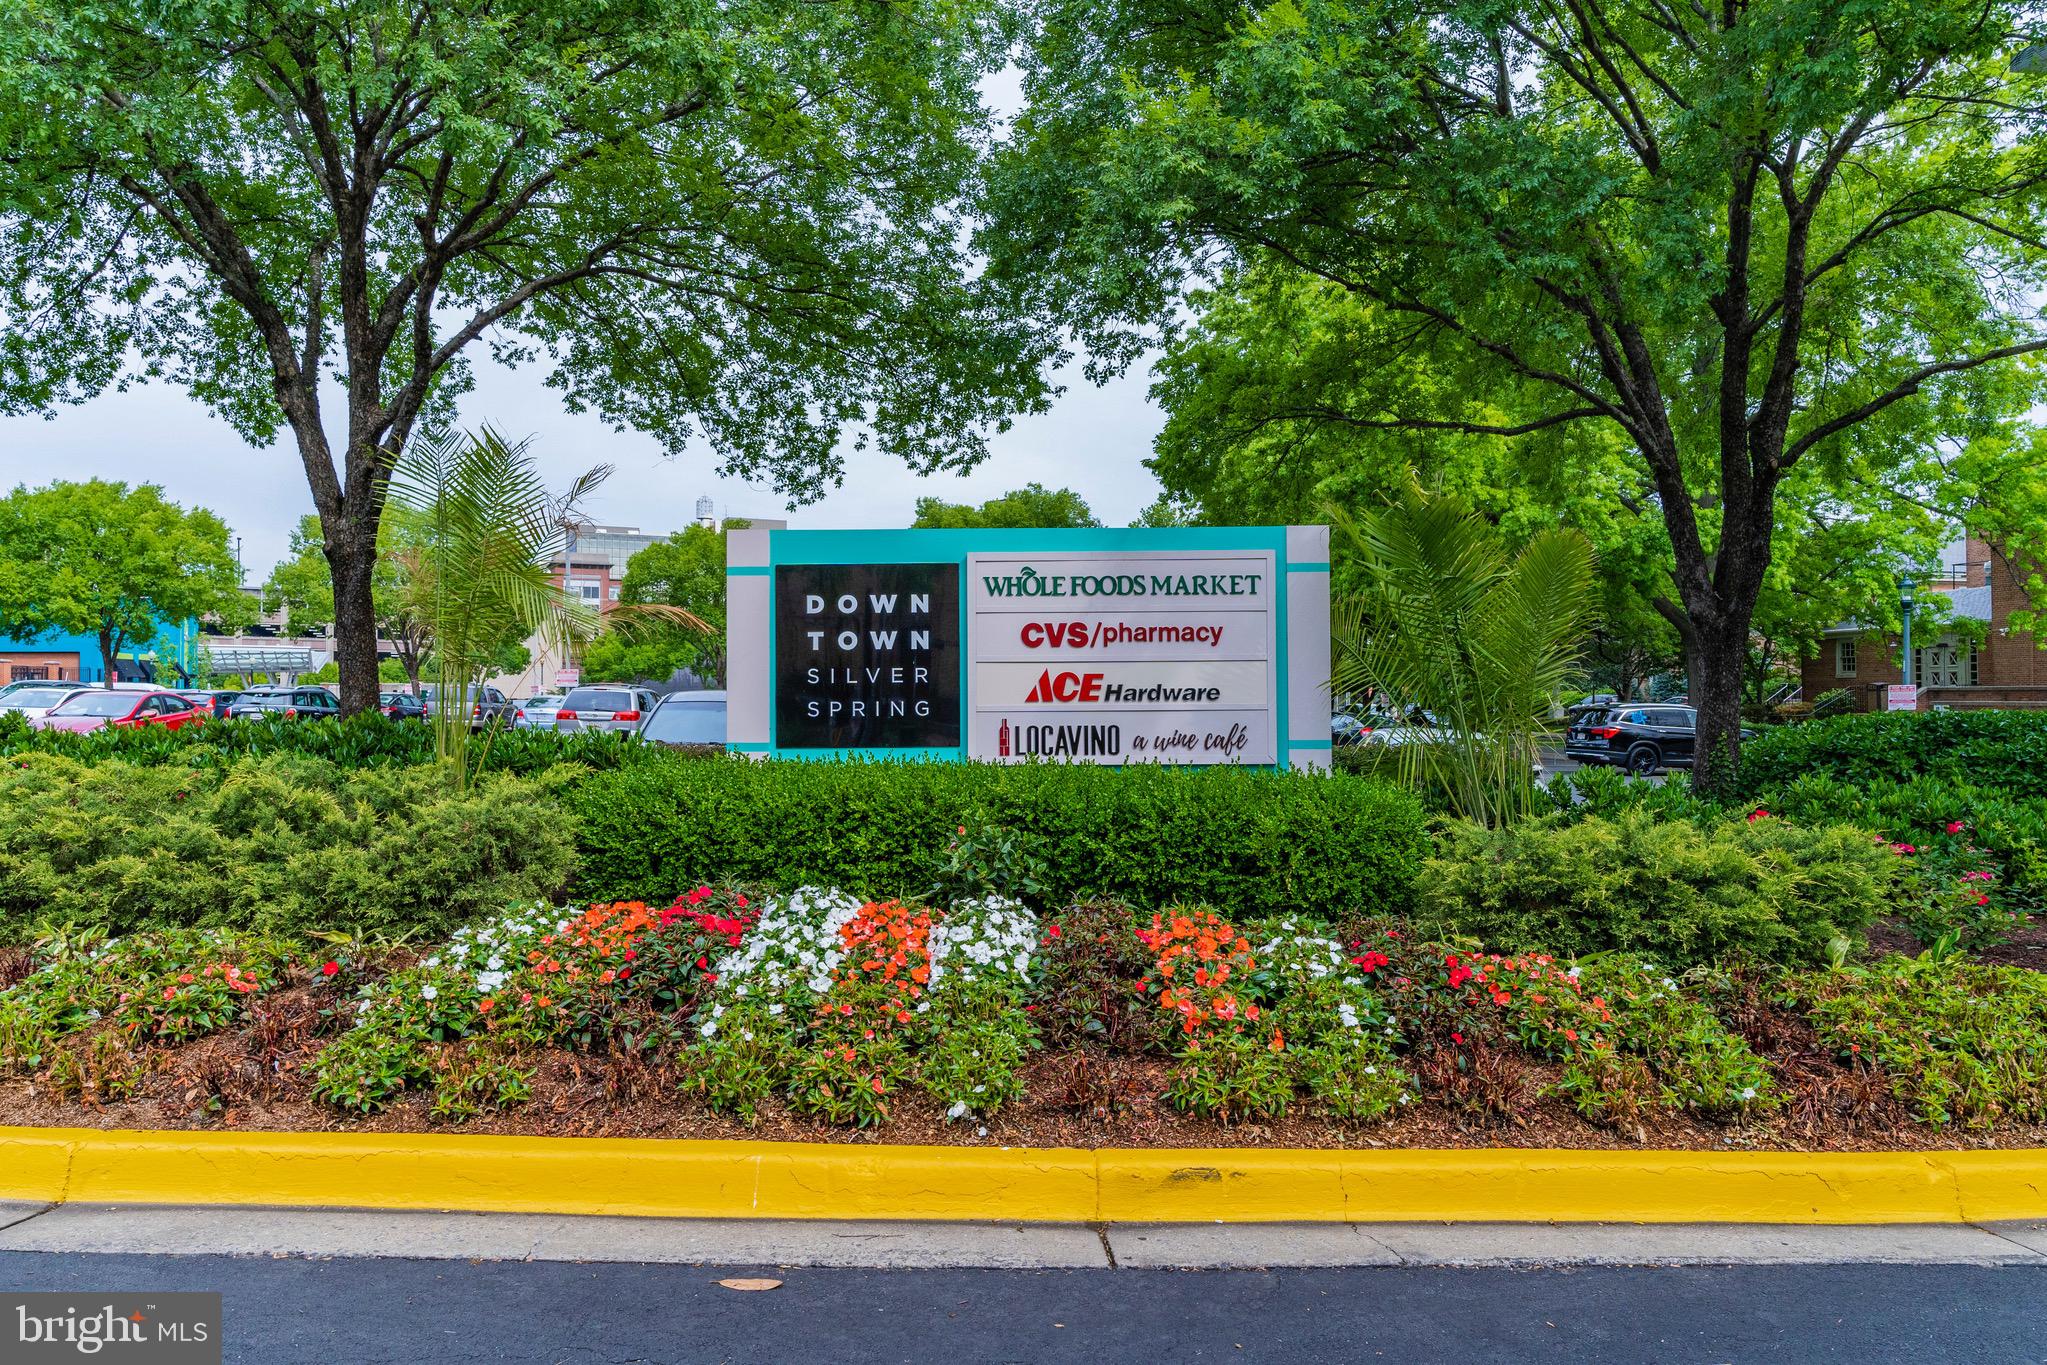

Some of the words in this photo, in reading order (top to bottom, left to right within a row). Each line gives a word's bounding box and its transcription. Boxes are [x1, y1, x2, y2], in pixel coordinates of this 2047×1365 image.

[982, 575, 1065, 597] WHOLE
[1071, 576, 1146, 597] FOODS
[1151, 575, 1261, 596] MARKET
[806, 594, 929, 614] DOWN
[807, 630, 930, 650] TOWN
[807, 667, 928, 684] SILVER
[1025, 668, 1104, 703] ACE
[1104, 684, 1221, 702] Hardware
[807, 700, 930, 717] SPRING
[1014, 724, 1121, 756] LOCAVINO
[1133, 736, 1148, 750] a
[1154, 729, 1198, 750] wine
[1203, 722, 1249, 757] café
